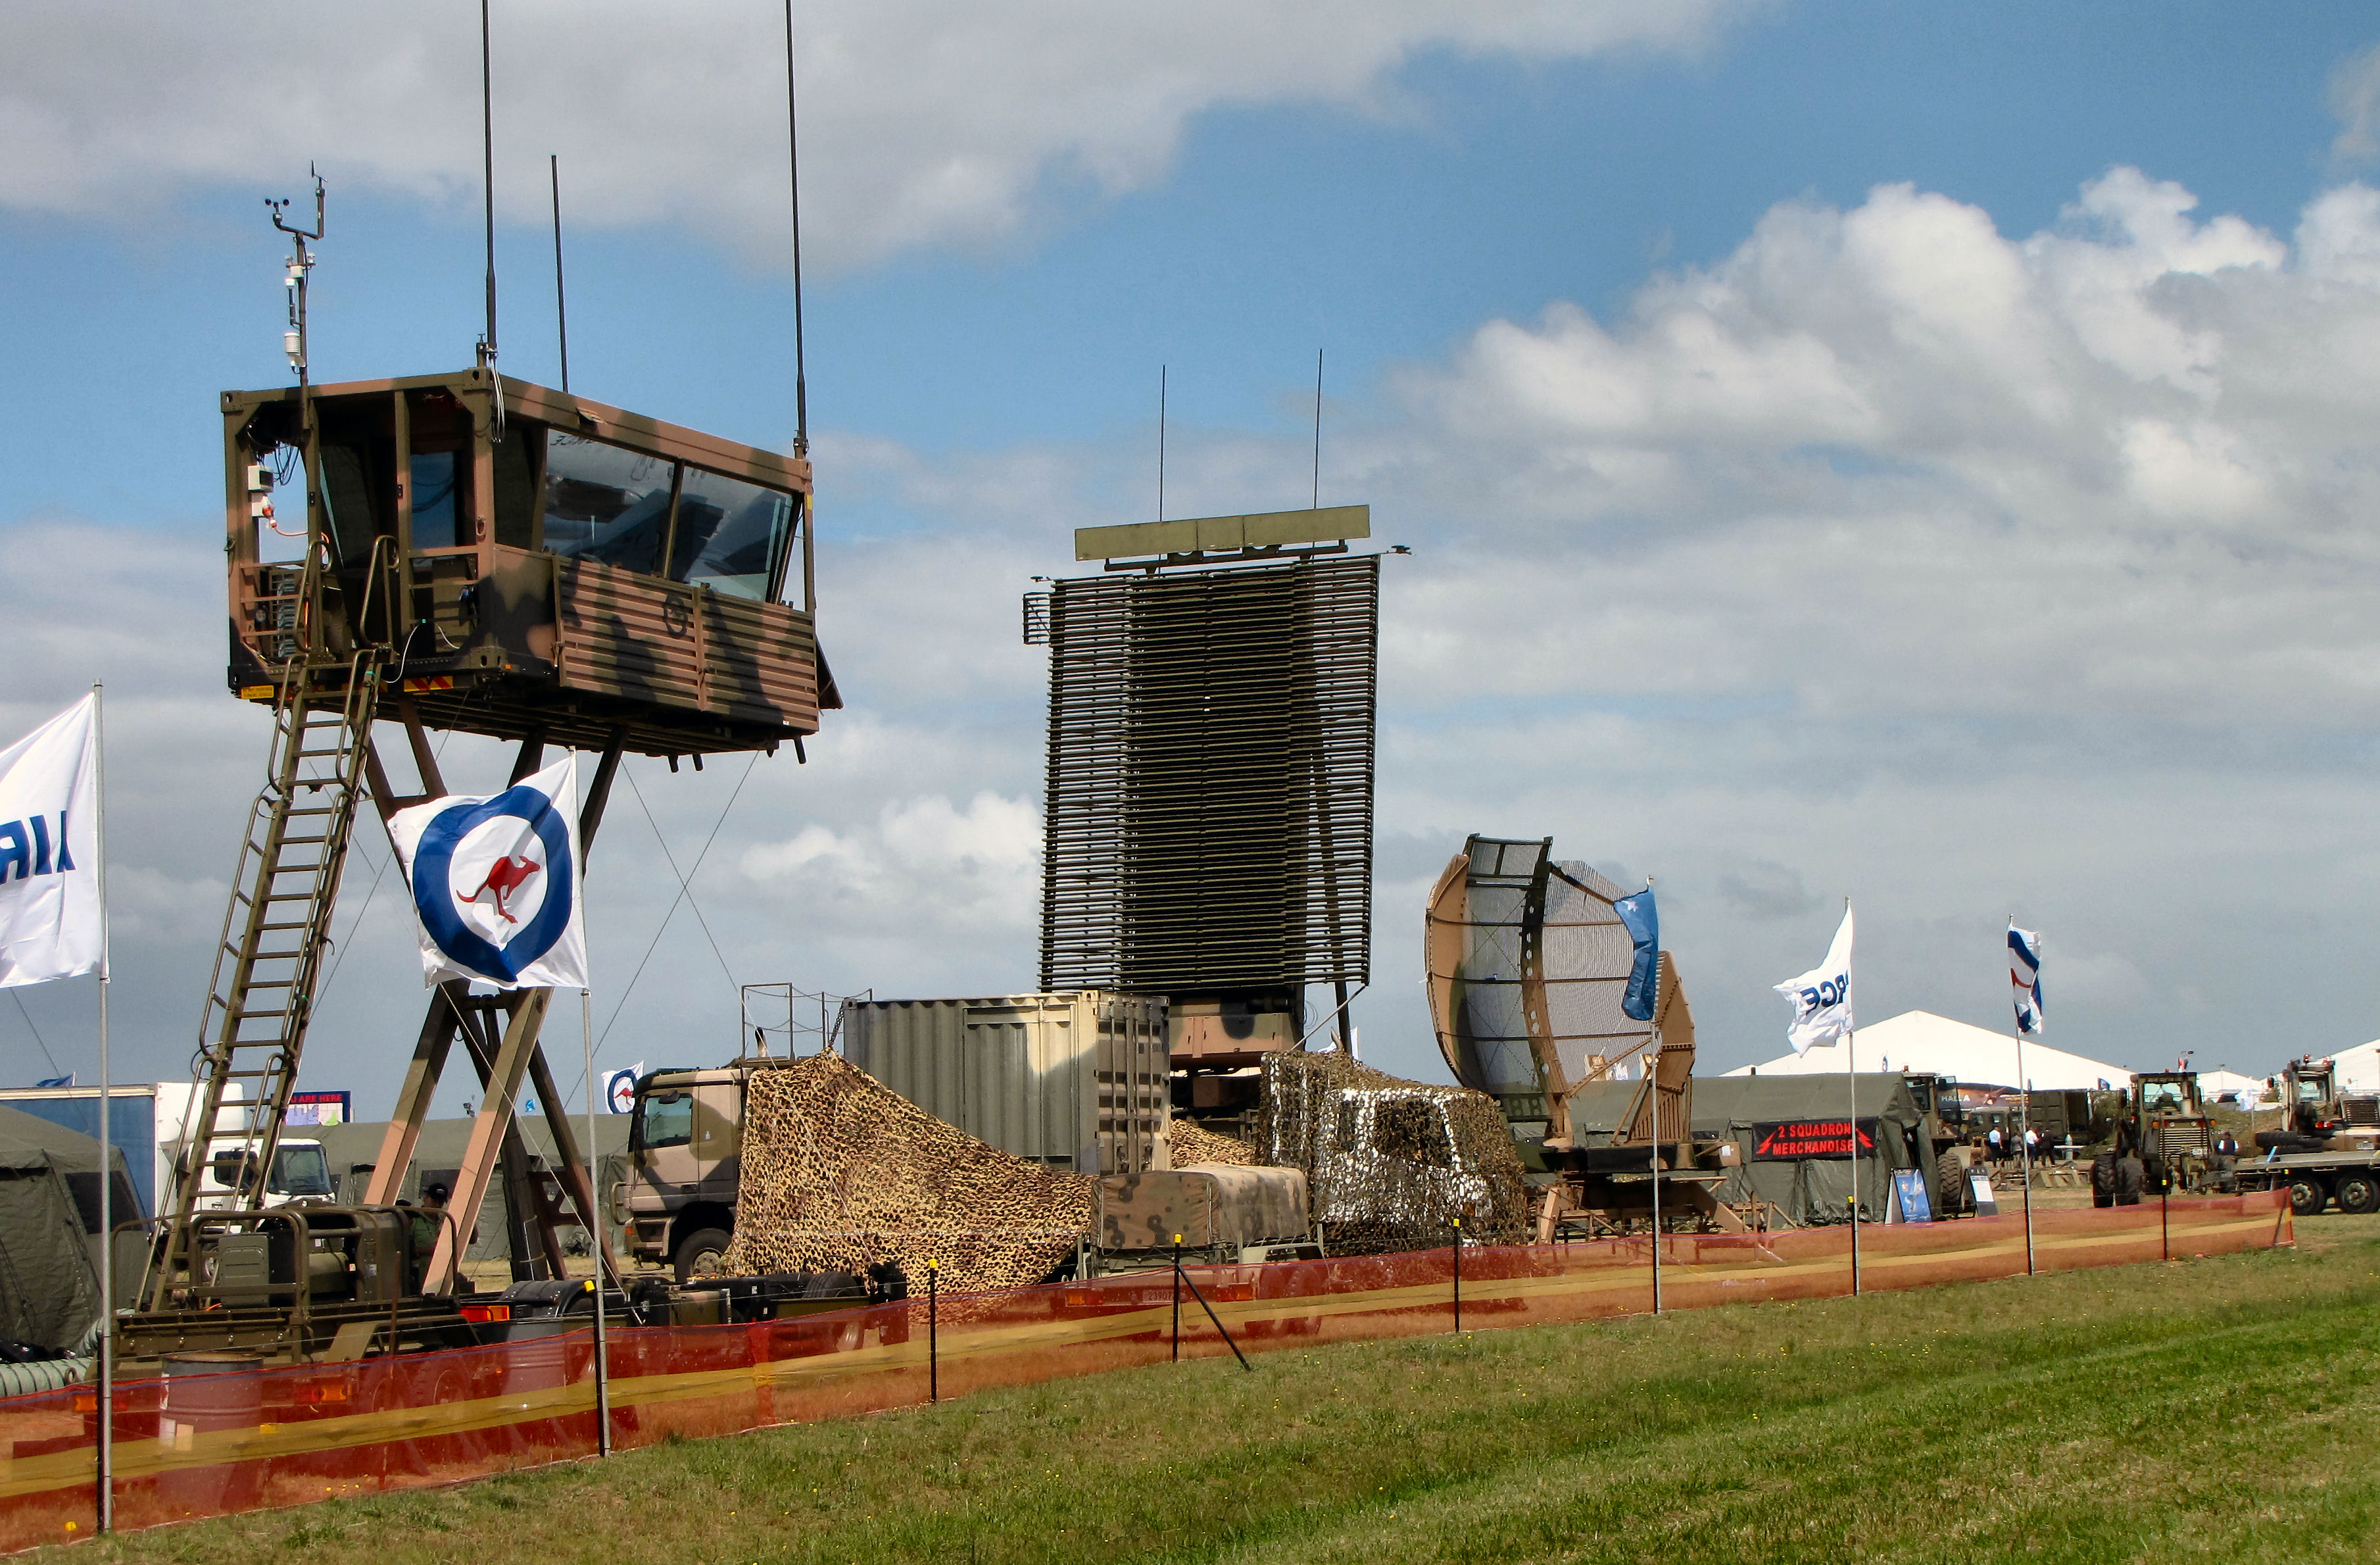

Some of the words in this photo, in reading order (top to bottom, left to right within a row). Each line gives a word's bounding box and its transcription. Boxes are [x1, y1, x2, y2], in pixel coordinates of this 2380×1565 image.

[299, 1095, 316, 1103] ARE
[1778, 1126, 1786, 1138] 2
[1789, 1122, 1852, 1137] SQUADRON
[1773, 1139, 1854, 1155] MERCHANDISE
